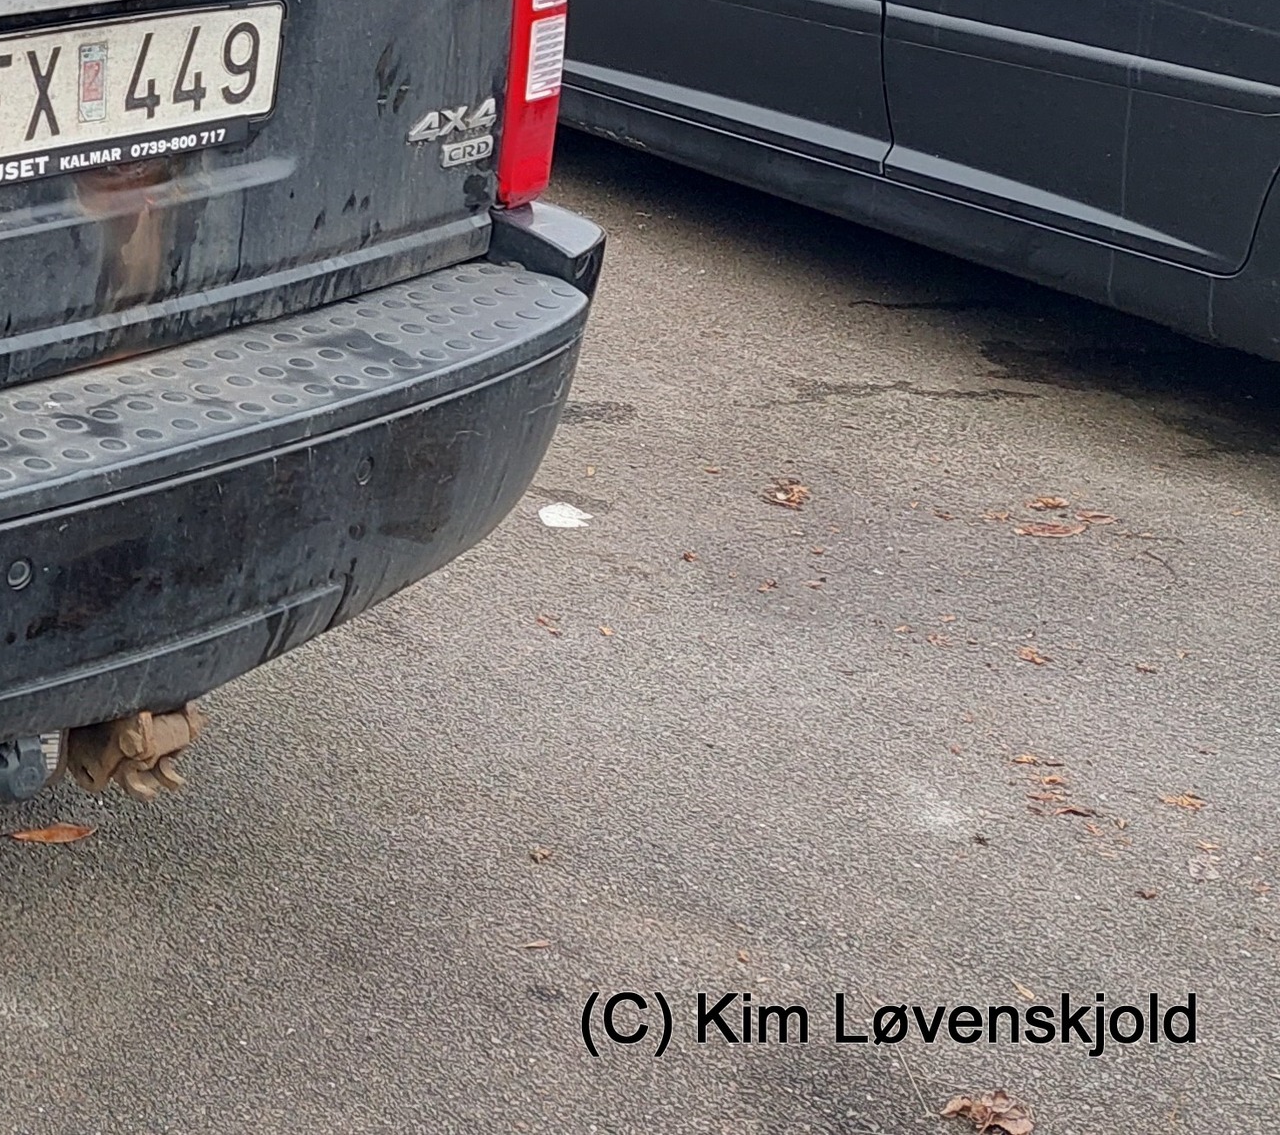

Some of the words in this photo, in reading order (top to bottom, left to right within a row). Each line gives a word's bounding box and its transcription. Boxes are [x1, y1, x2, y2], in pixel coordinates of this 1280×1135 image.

[124, 21, 261, 120] 449
[60, 147, 122, 171] KALMAR
[130, 133, 197, 158] 0739-800
[200, 128, 226, 145] 717
[448, 140, 490, 162] CRD
